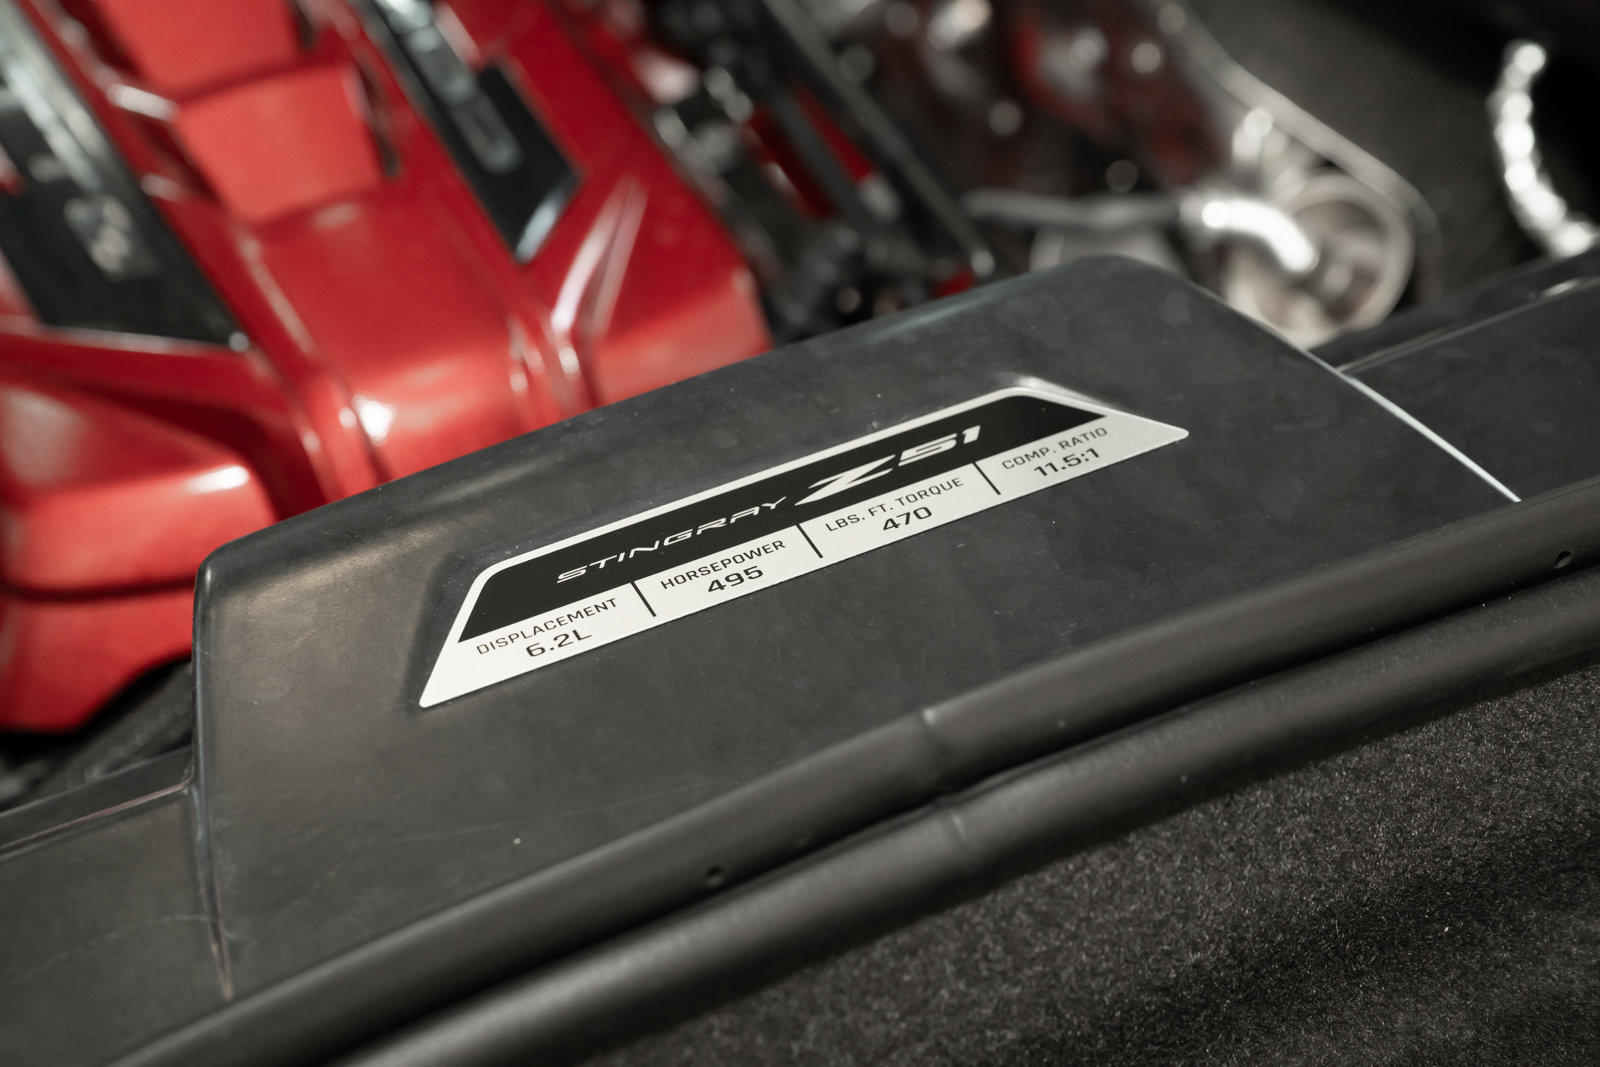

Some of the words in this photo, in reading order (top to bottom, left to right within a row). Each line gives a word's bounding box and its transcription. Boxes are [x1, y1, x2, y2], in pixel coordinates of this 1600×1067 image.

[1002, 447, 1058, 470] COMP.
[1059, 426, 1108, 448] RATIO
[1034, 447, 1100, 477] 11.5:1
[556, 496, 787, 583] STINGRAY
[794, 425, 981, 506] Z51
[825, 512, 866, 532] LBS.
[867, 502, 894, 518] FT.
[895, 477, 964, 508] TORQUE
[882, 506, 933, 531] 470
[660, 539, 786, 590] HORSEPOWER
[707, 565, 764, 593] 495
[476, 597, 618, 655] DISPLACEMENT
[526, 628, 592, 658] 6.2L
